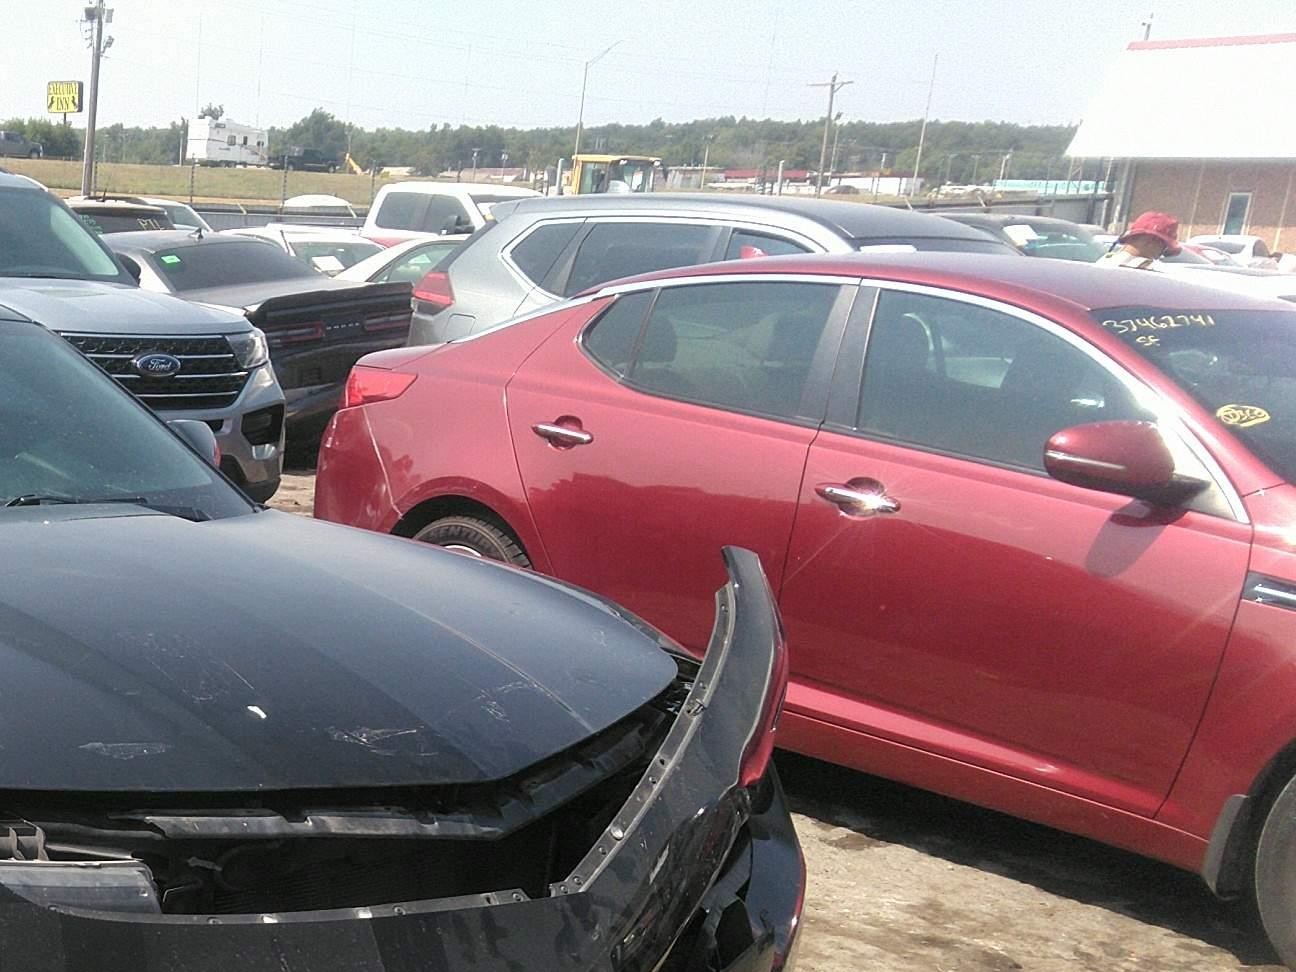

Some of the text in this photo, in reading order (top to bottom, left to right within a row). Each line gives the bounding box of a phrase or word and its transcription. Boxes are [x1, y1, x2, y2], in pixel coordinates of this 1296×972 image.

[56, 96, 70, 110] INN
[1102, 315, 1216, 334] 37462741
[148, 359, 172, 370] Ford
